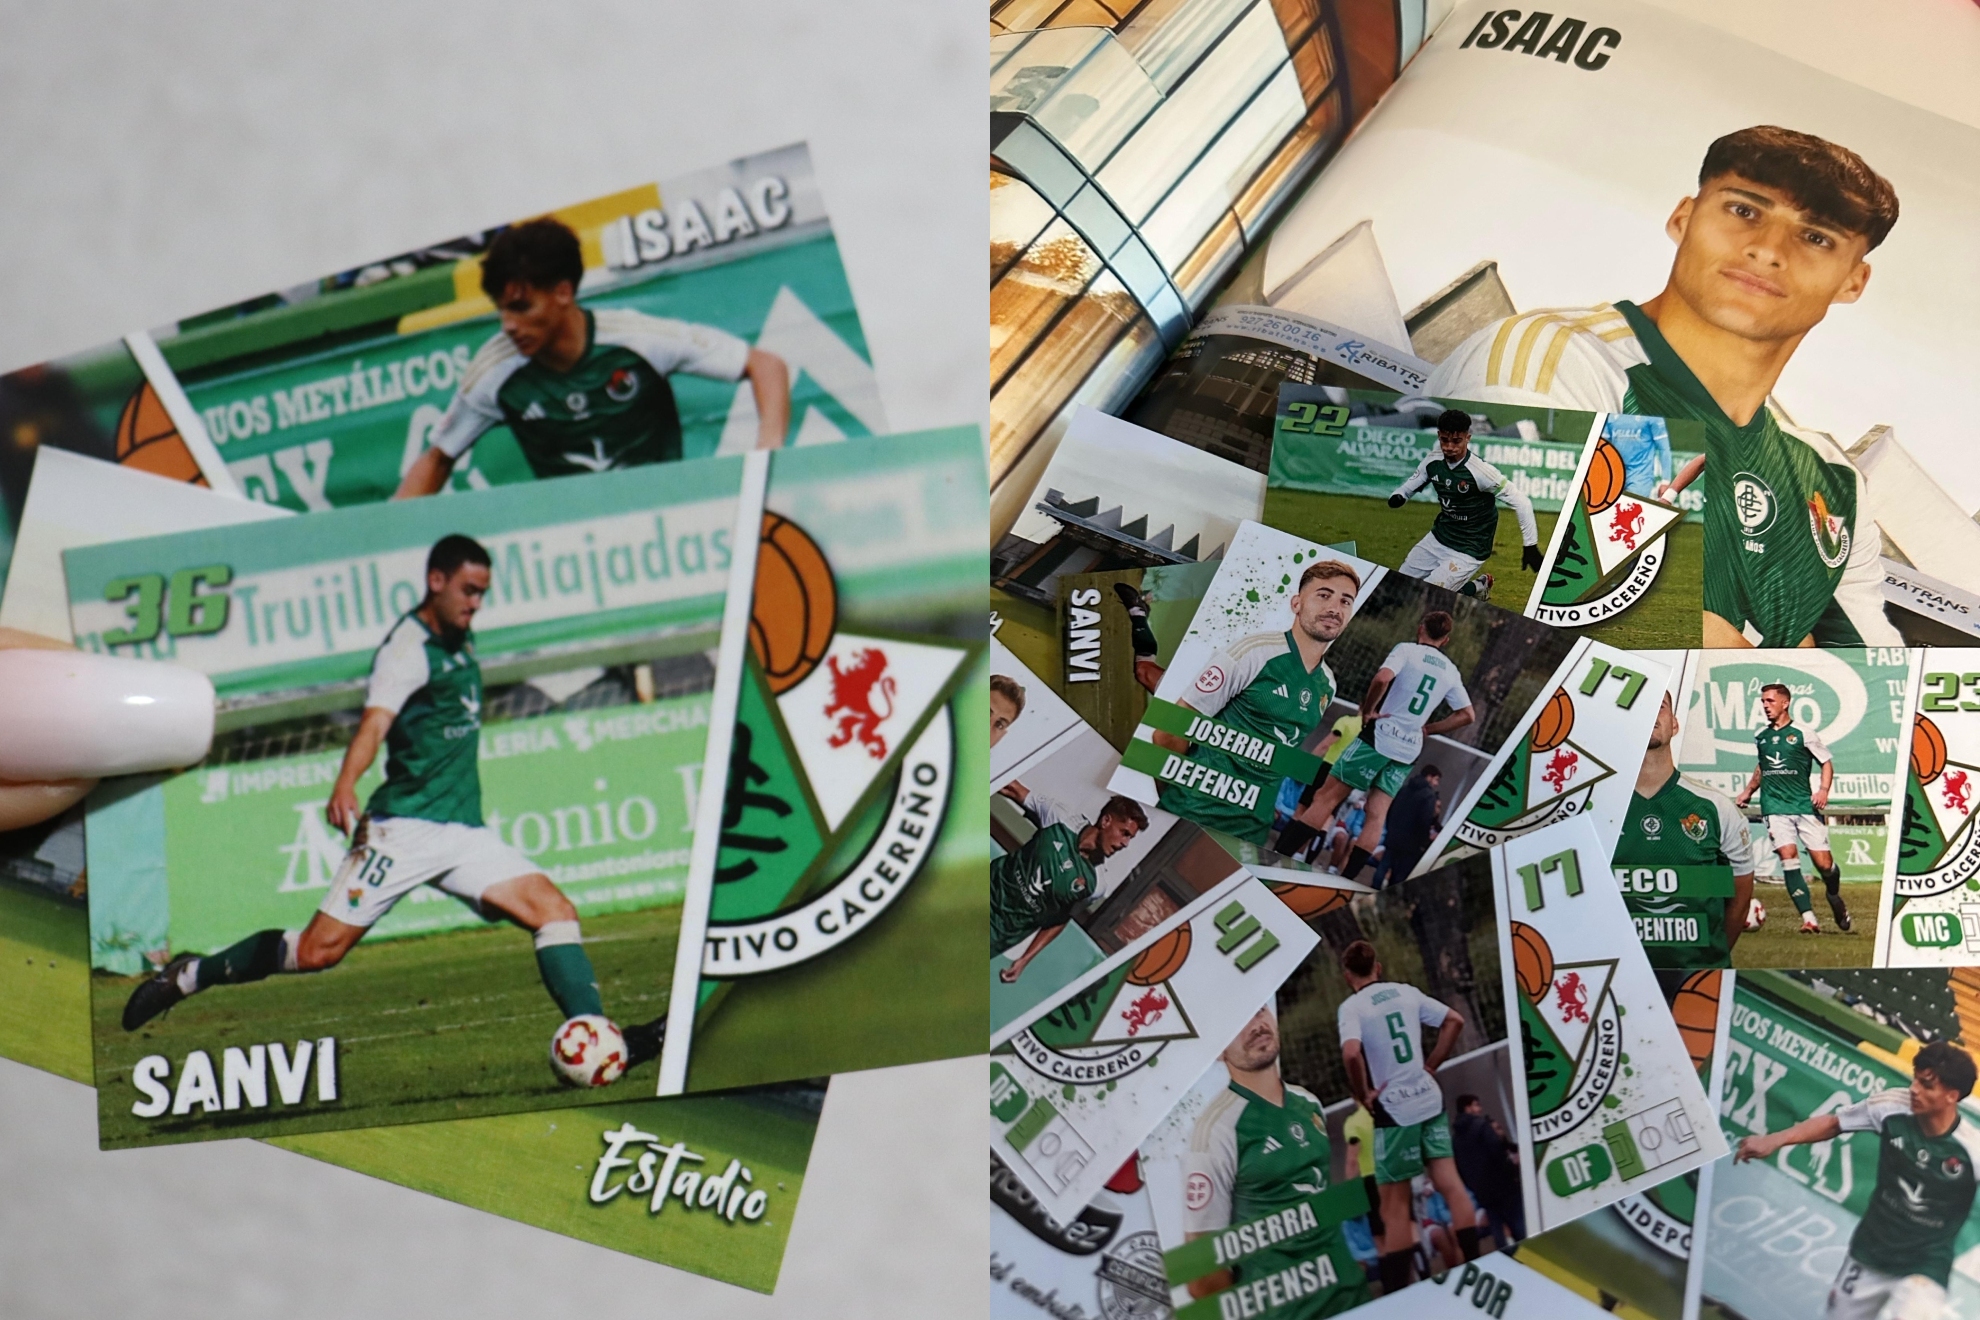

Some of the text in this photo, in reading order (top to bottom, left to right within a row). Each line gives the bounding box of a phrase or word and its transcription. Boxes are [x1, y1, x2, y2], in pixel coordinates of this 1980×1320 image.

[1459, 9, 1622, 72] ISAAC
[619, 177, 790, 268] ISAAC
[1263, 319, 1282, 330] 26
[1282, 324, 1302, 336] 00
[1302, 330, 1322, 342] 16
[273, 345, 470, 430] METÁLICOS
[1280, 402, 1350, 436] 22
[103, 563, 233, 646] 36
[233, 515, 731, 650] Trujillo Miajadas
[1537, 553, 1658, 621] TIVO CACEREÑO
[1068, 588, 1102, 683] SANVI
[1407, 673, 1437, 716] 5
[1578, 657, 1648, 710] 17
[1709, 681, 1822, 731] MAO
[1185, 716, 1276, 766] JOSERRA
[1160, 754, 1261, 811] DEFENSA
[1832, 776, 1890, 798] Trujillo
[706, 925, 799, 962] TIVO
[815, 761, 938, 935] CACEREÑO
[1461, 823, 1497, 845] TIVO
[1516, 848, 1584, 912] 17
[1898, 877, 1937, 890] TIVO
[1213, 899, 1280, 973] 41
[1913, 915, 1951, 943] MC
[1017, 1030, 1142, 1079] TIVO CACEREÑO
[1385, 1011, 1414, 1064] 5
[1770, 1021, 1888, 1097] METÁLICOS
[131, 1037, 338, 1118] SANVI
[1533, 1016, 1615, 1136] TIVO CACEREÑO
[590, 1122, 768, 1222] Estadio
[1562, 1150, 1593, 1189] DF
[1212, 1201, 1319, 1265] JOSERRA
[1218, 1253, 1339, 1320] DEFENSA
[1453, 1261, 1514, 1320] POR
